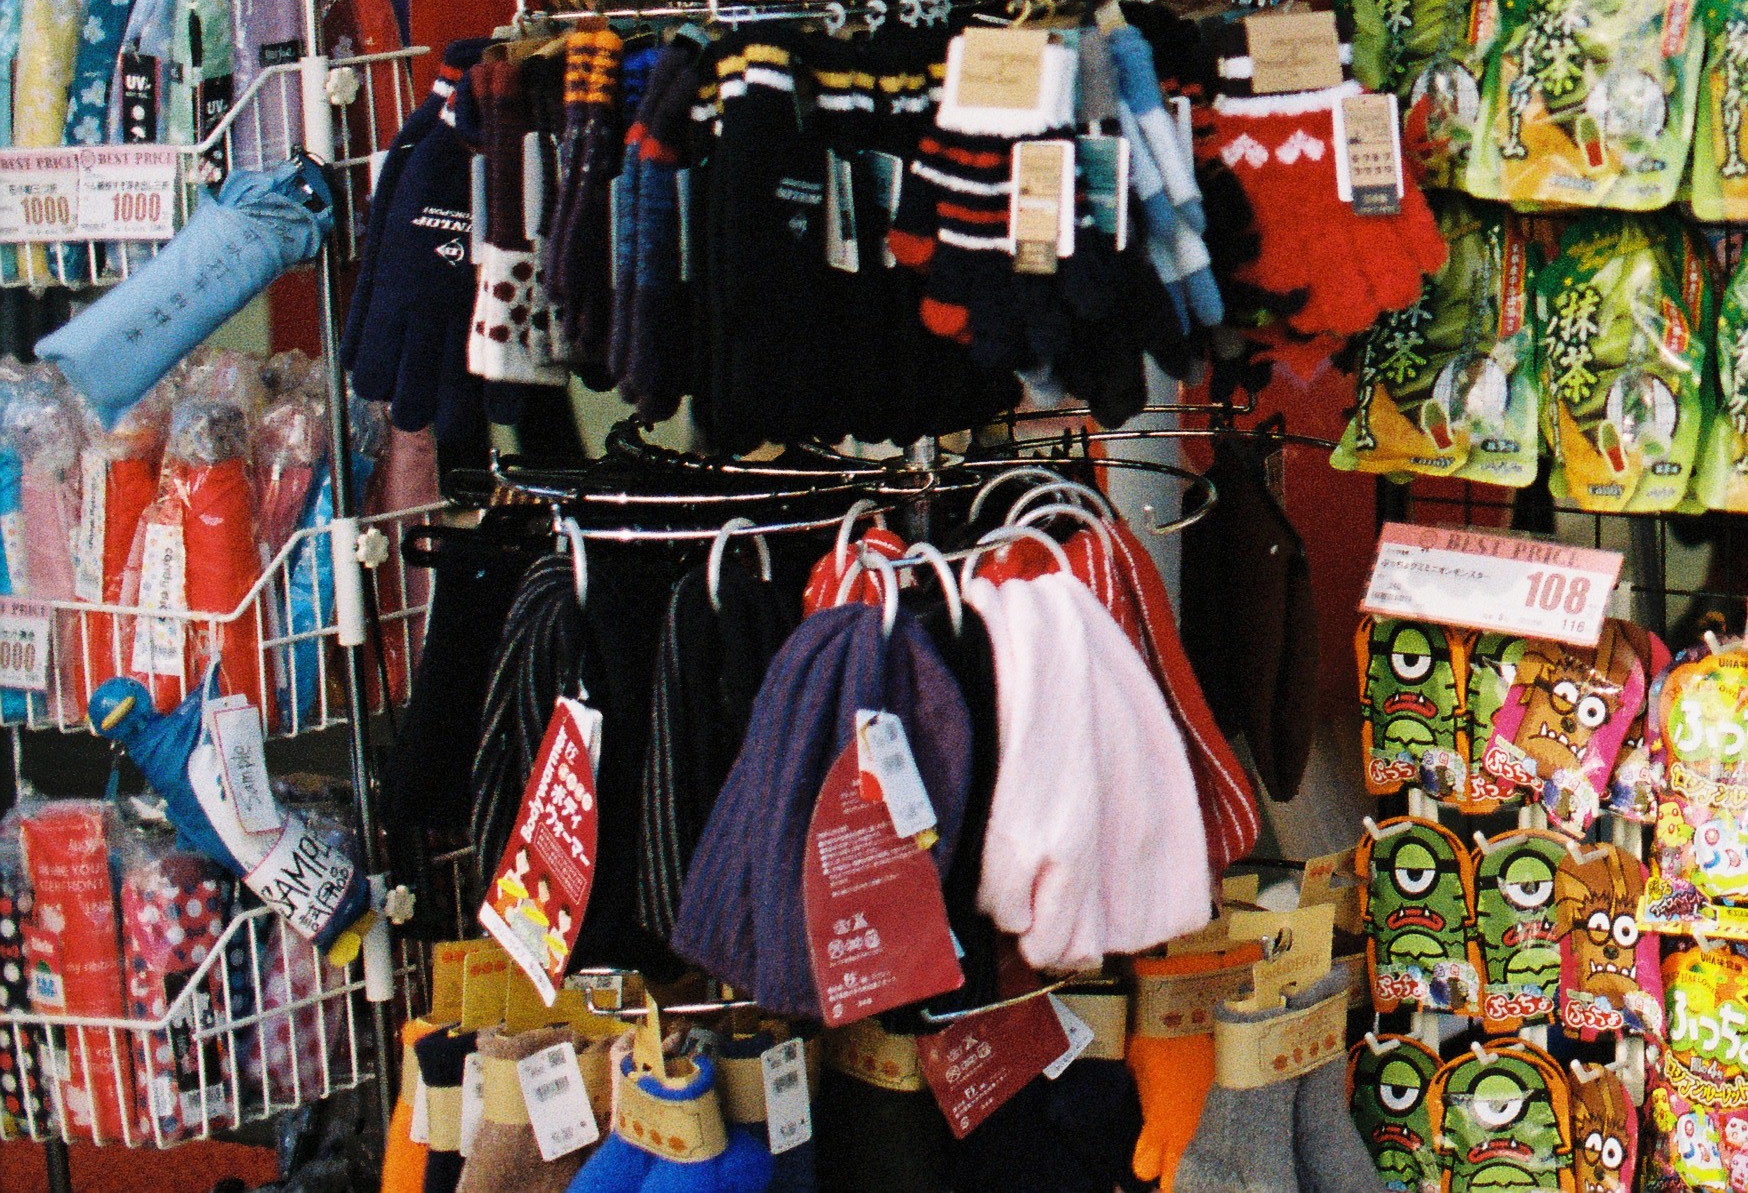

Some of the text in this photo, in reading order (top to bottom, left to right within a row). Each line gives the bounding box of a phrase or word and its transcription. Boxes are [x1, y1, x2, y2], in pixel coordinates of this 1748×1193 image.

[98, 151, 174, 165] BEST PRICE
[20, 196, 70, 226] 1000
[111, 192, 162, 223] 1000
[1446, 534, 1583, 569] BEST PRICE
[1525, 571, 1591, 616] 108
[1561, 618, 1585, 633] 116
[519, 724, 569, 844] Bodywarmer
[551, 783, 584, 830] ボディ
[545, 802, 591, 868] ウォーマー
[1486, 995, 1552, 1020] ぷっちょ
[1568, 1002, 1622, 1028] ぷっちょ
